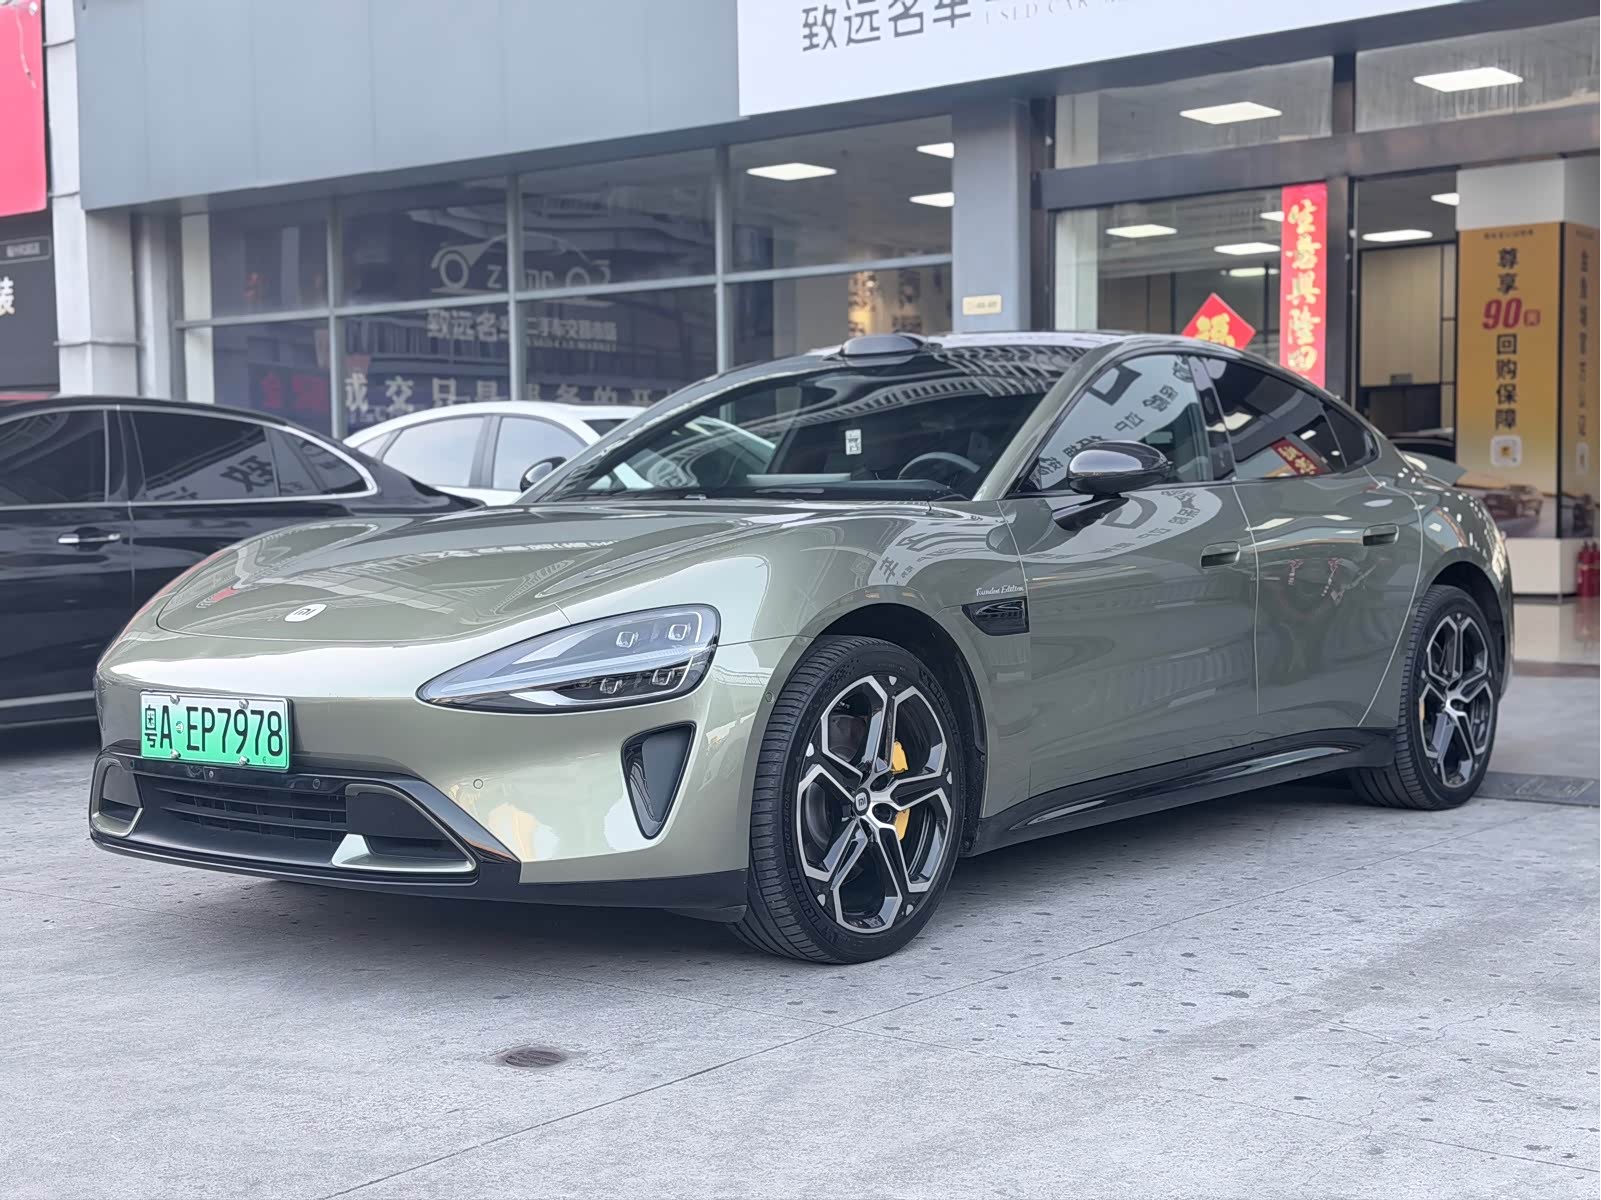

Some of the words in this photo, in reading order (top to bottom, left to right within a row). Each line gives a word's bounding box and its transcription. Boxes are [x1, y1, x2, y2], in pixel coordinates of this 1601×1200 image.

[802, 0, 971, 51] 致远名车
[1496, 247, 1518, 295] 尊享
[1495, 333, 1518, 431] 回购保障
